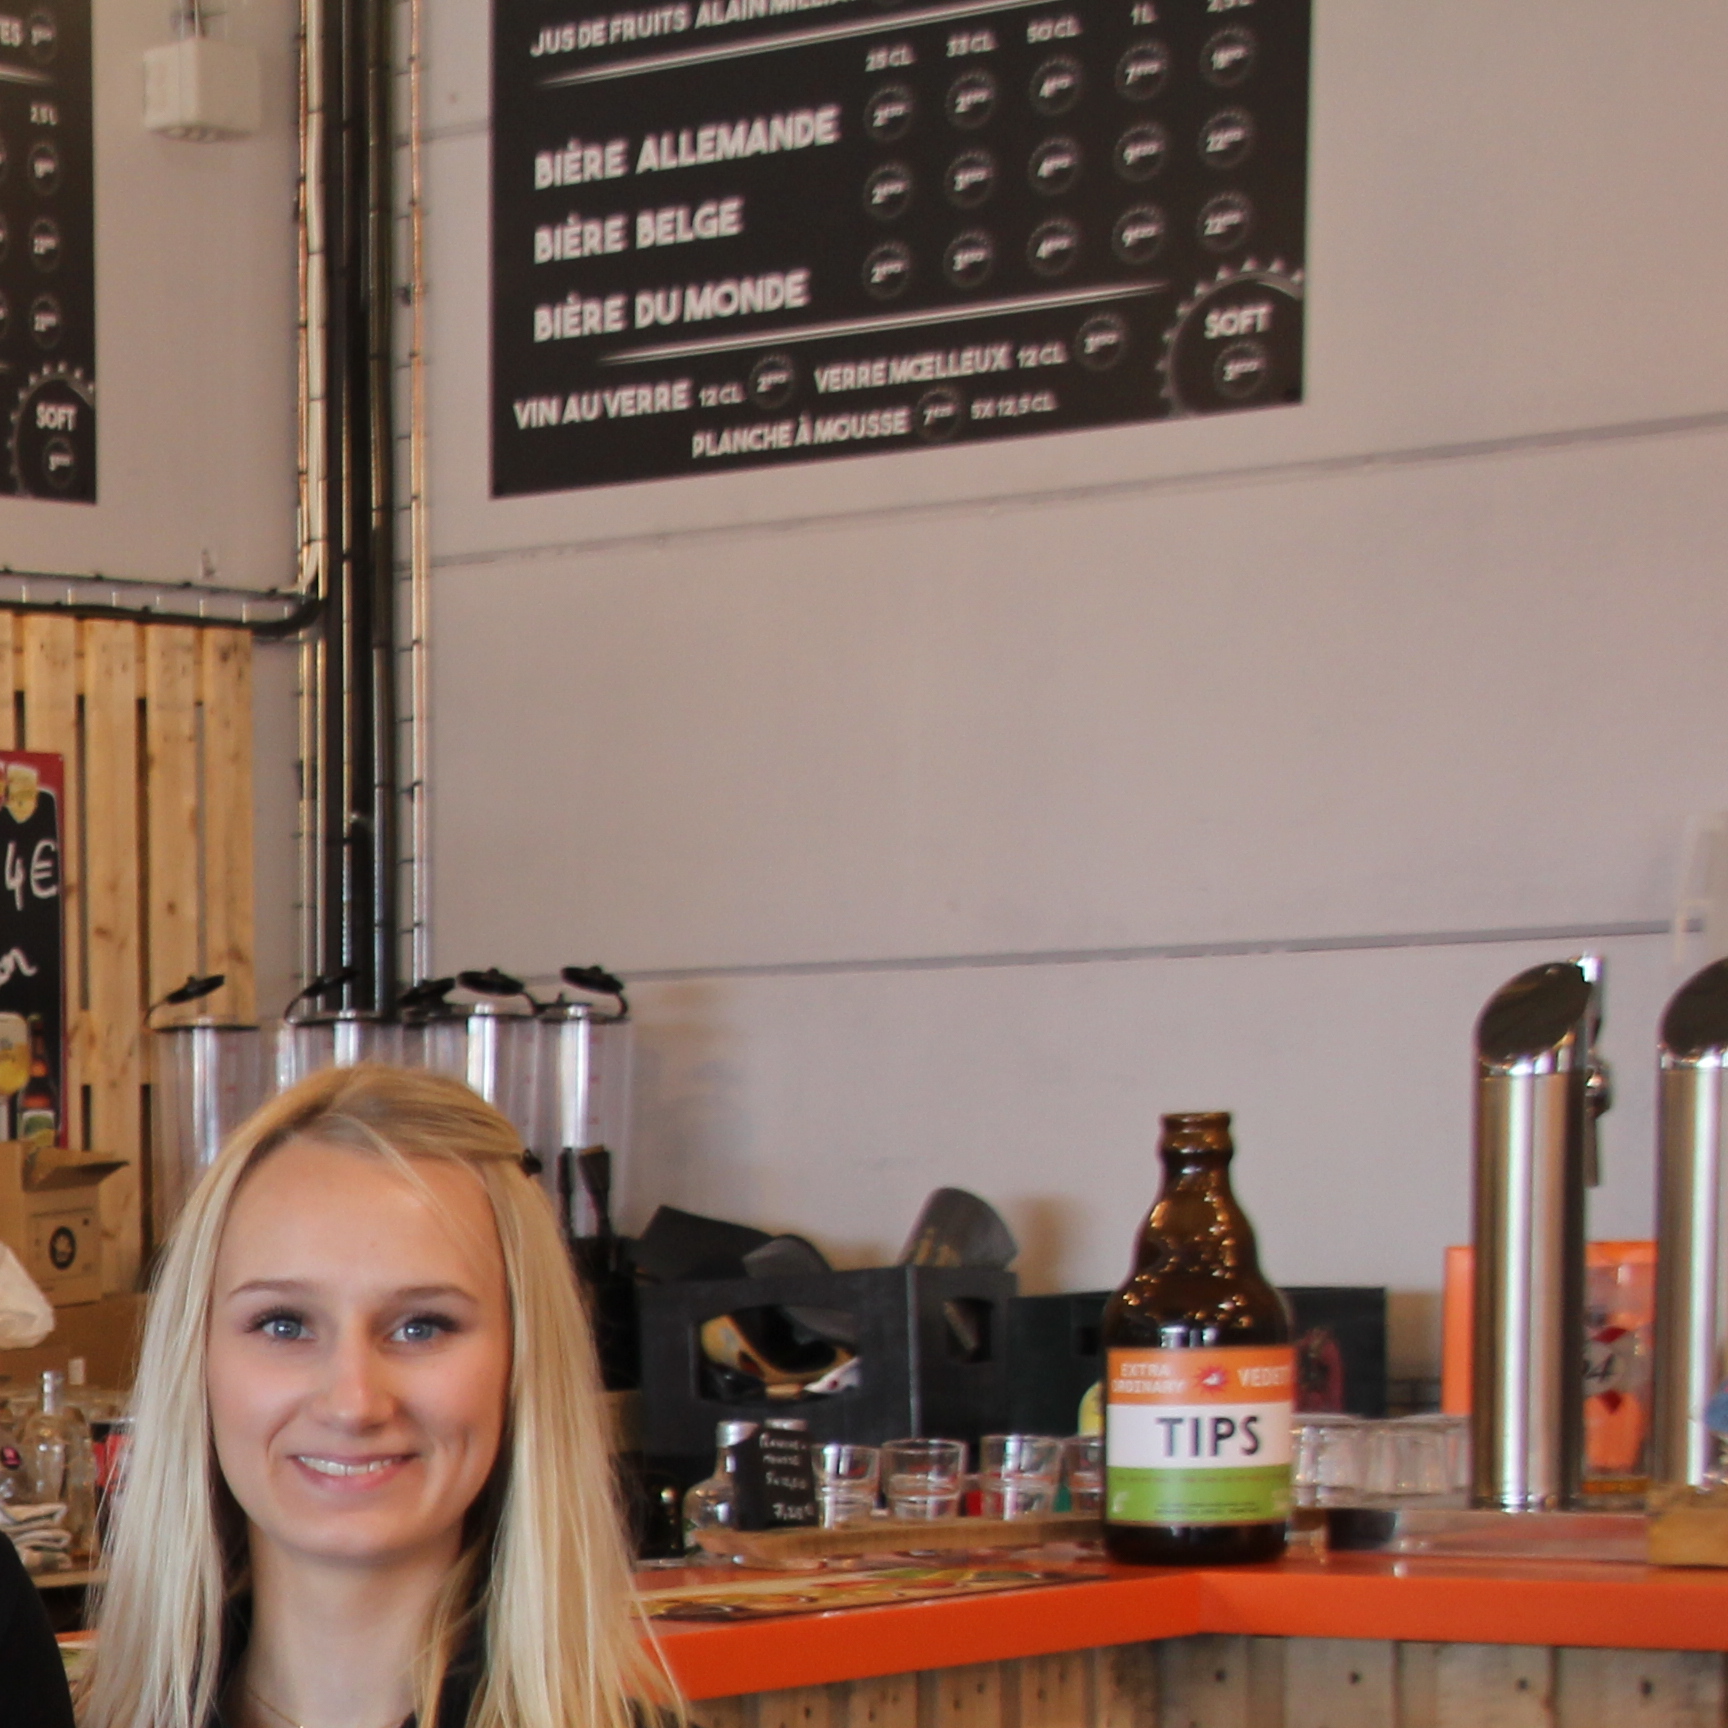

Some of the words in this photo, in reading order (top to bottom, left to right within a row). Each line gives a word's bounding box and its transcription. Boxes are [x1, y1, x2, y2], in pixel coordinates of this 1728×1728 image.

[530, 23, 575, 57] JUS
[577, 19, 609, 49] DE
[610, 3, 693, 44] FRUITS
[889, 41, 916, 67] CL
[534, 135, 628, 190] BIÈRE
[636, 103, 841, 174] ALLEMANDE
[534, 211, 628, 264] BIÈRE
[636, 195, 744, 249] BELGE
[534, 290, 628, 342] BIÈRE
[635, 285, 682, 328] DU
[683, 266, 811, 322] MONDE
[1204, 303, 1273, 339] SOFT
[814, 357, 887, 394] VERRE
[1037, 342, 1067, 365] CL
[37, 401, 77, 432] SOFT
[513, 397, 561, 430] VIN
[562, 392, 602, 423] AU
[603, 377, 693, 419] VERRE
[699, 386, 718, 408] 12
[719, 381, 747, 405] CL
[692, 416, 793, 458] PLANCHE
[794, 410, 813, 446] À
[814, 406, 912, 444] MOUSSE
[1121, 1363, 1171, 1377] EXTRA
[1155, 1416, 1259, 1457] TIPS
